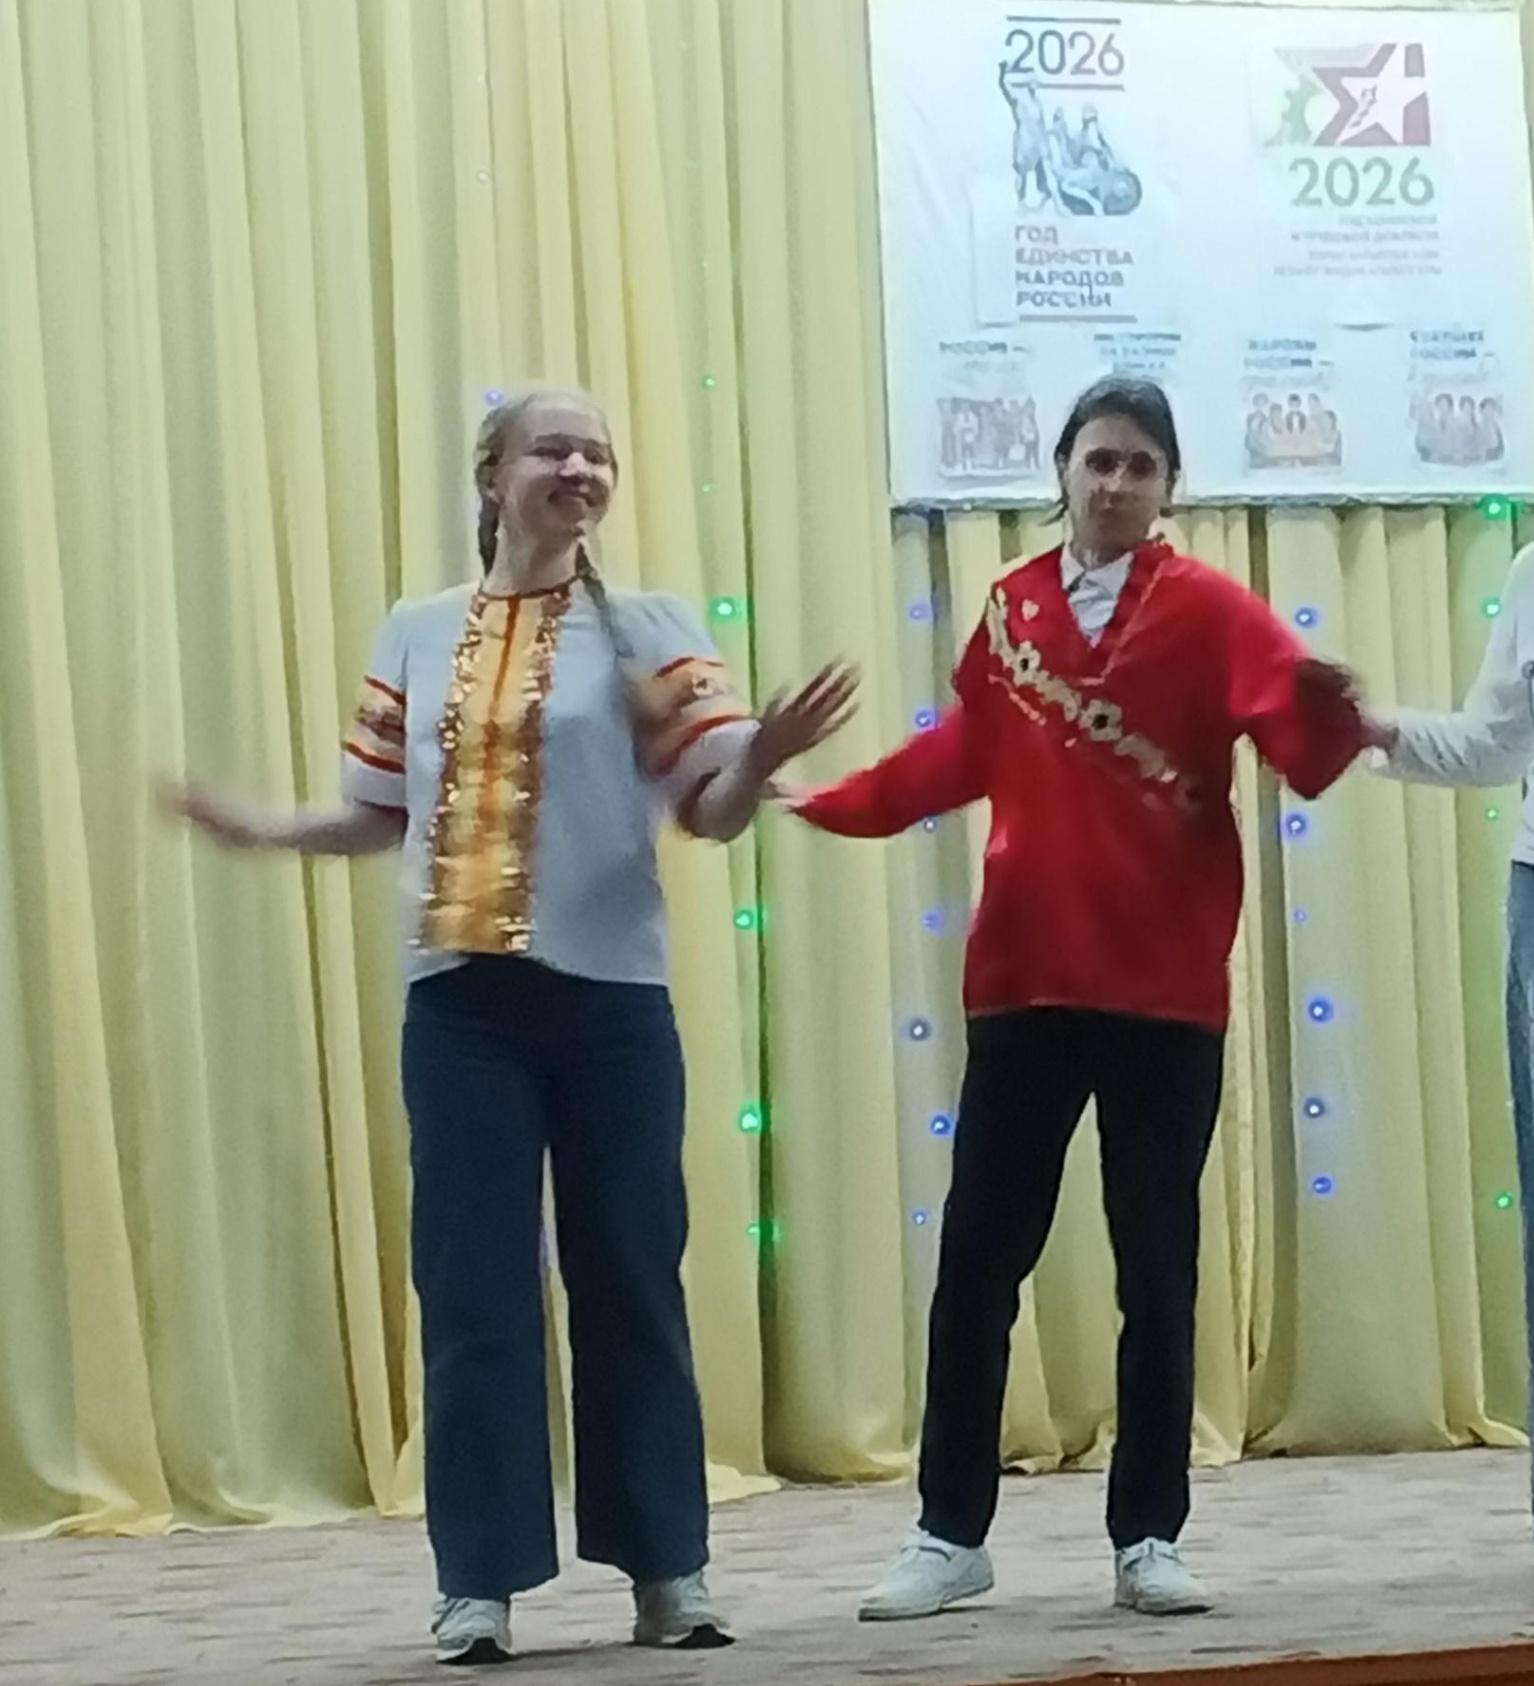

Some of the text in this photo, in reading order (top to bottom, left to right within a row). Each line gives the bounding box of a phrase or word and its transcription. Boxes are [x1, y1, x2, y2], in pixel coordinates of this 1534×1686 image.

[1005, 29, 1125, 76] 2026
[1288, 156, 1435, 207] 2026
[1015, 225, 1058, 244] ГОД
[1015, 248, 1134, 265] ЕДИНСТВА
[1015, 270, 1124, 286] НАРОДОВ
